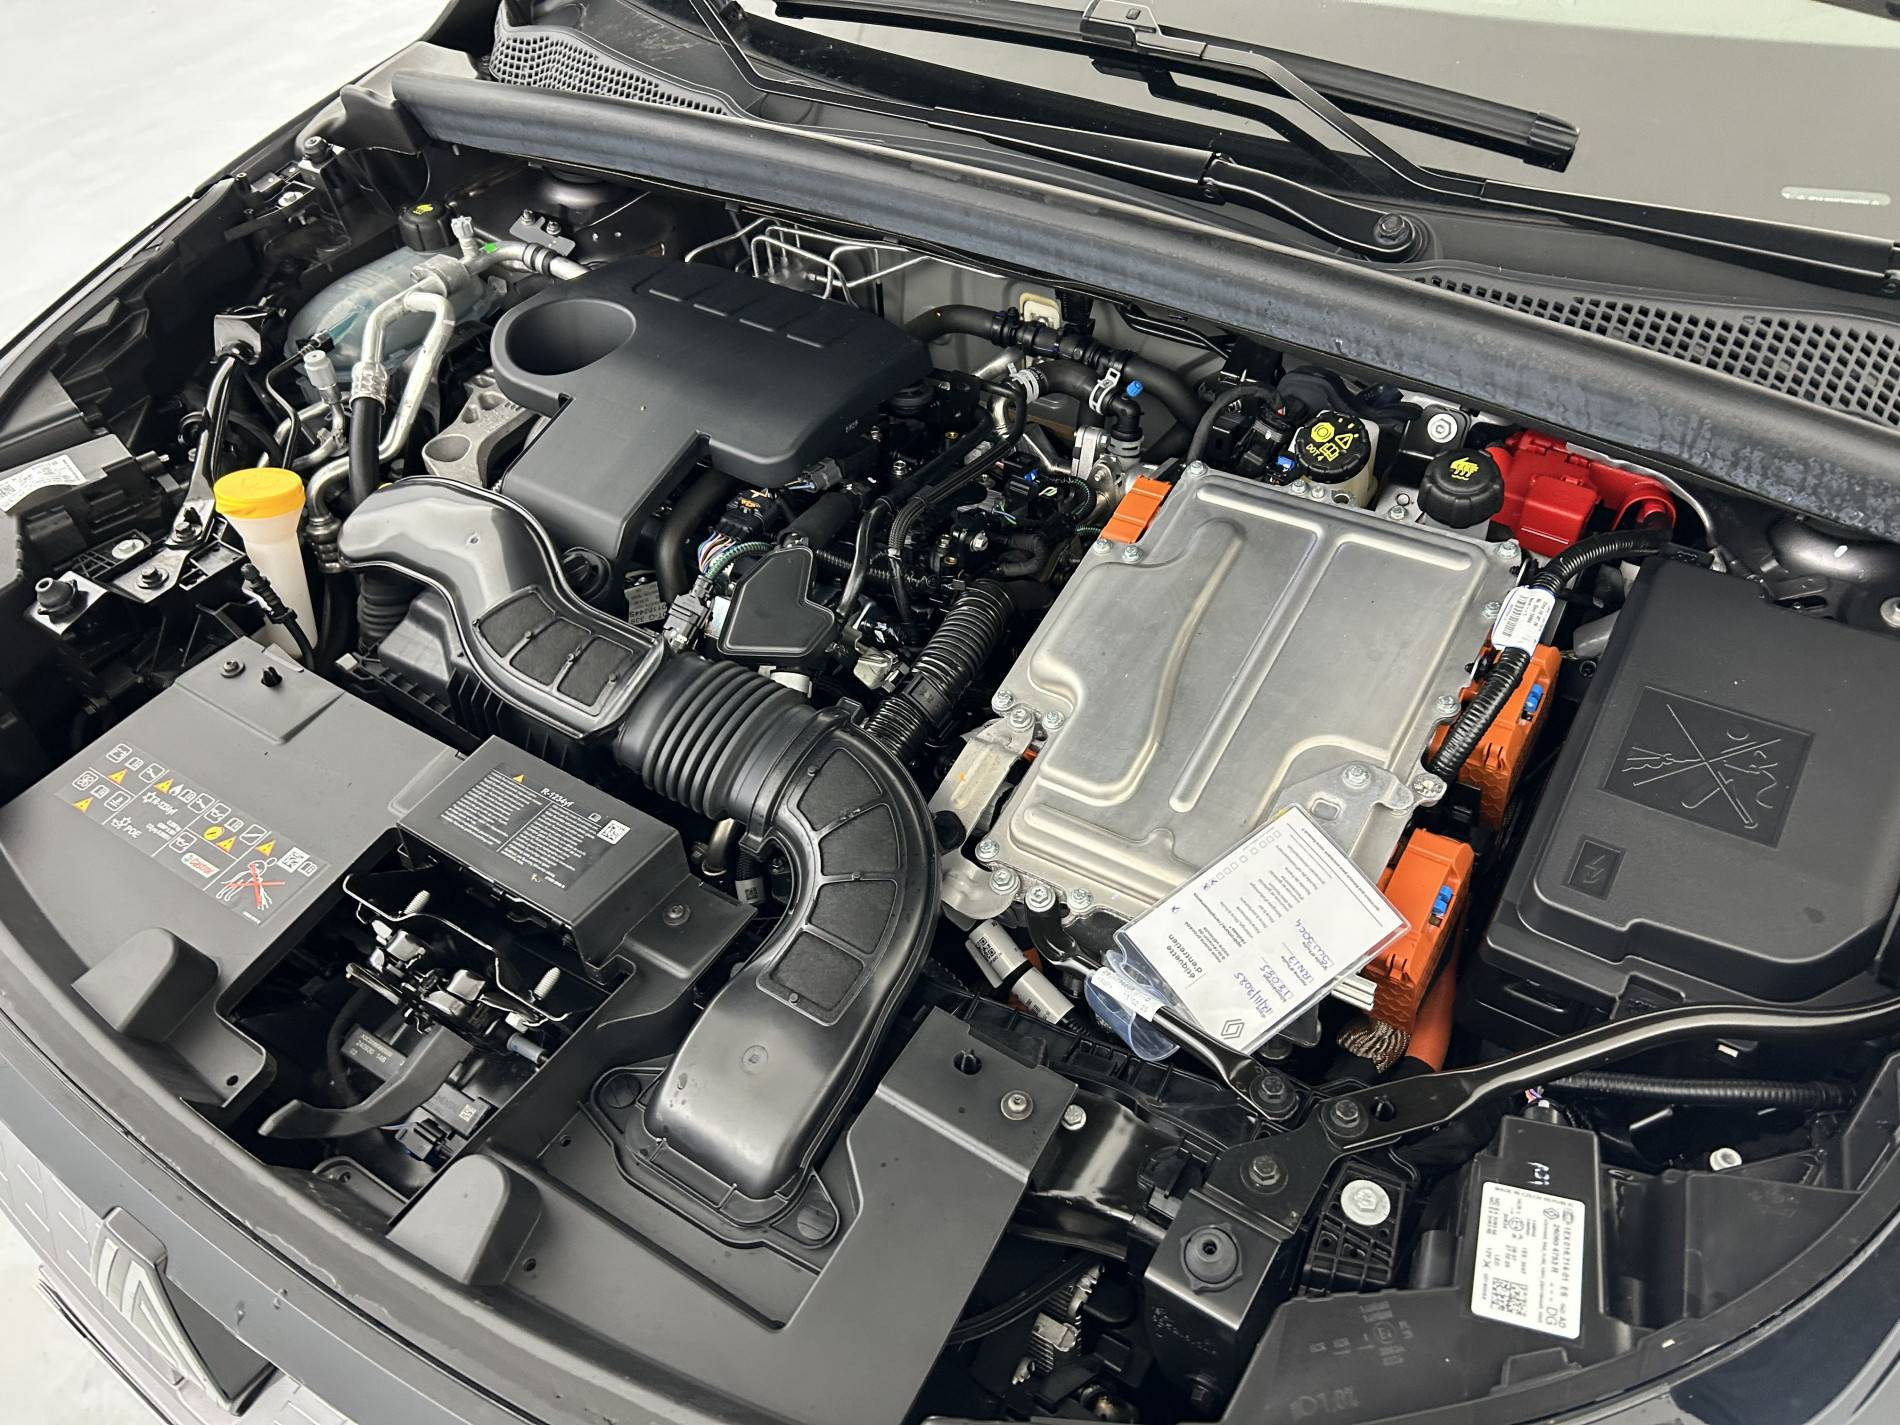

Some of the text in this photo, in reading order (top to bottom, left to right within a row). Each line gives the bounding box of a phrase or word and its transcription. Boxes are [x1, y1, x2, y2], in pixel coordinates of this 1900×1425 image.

[1305, 443, 1320, 456] DOT
[540, 787, 574, 810] R-1234yf
[1165, 943, 1196, 979] étiquette
[1167, 933, 1203, 974] d'entretien
[1545, 1305, 1557, 1326] DG
